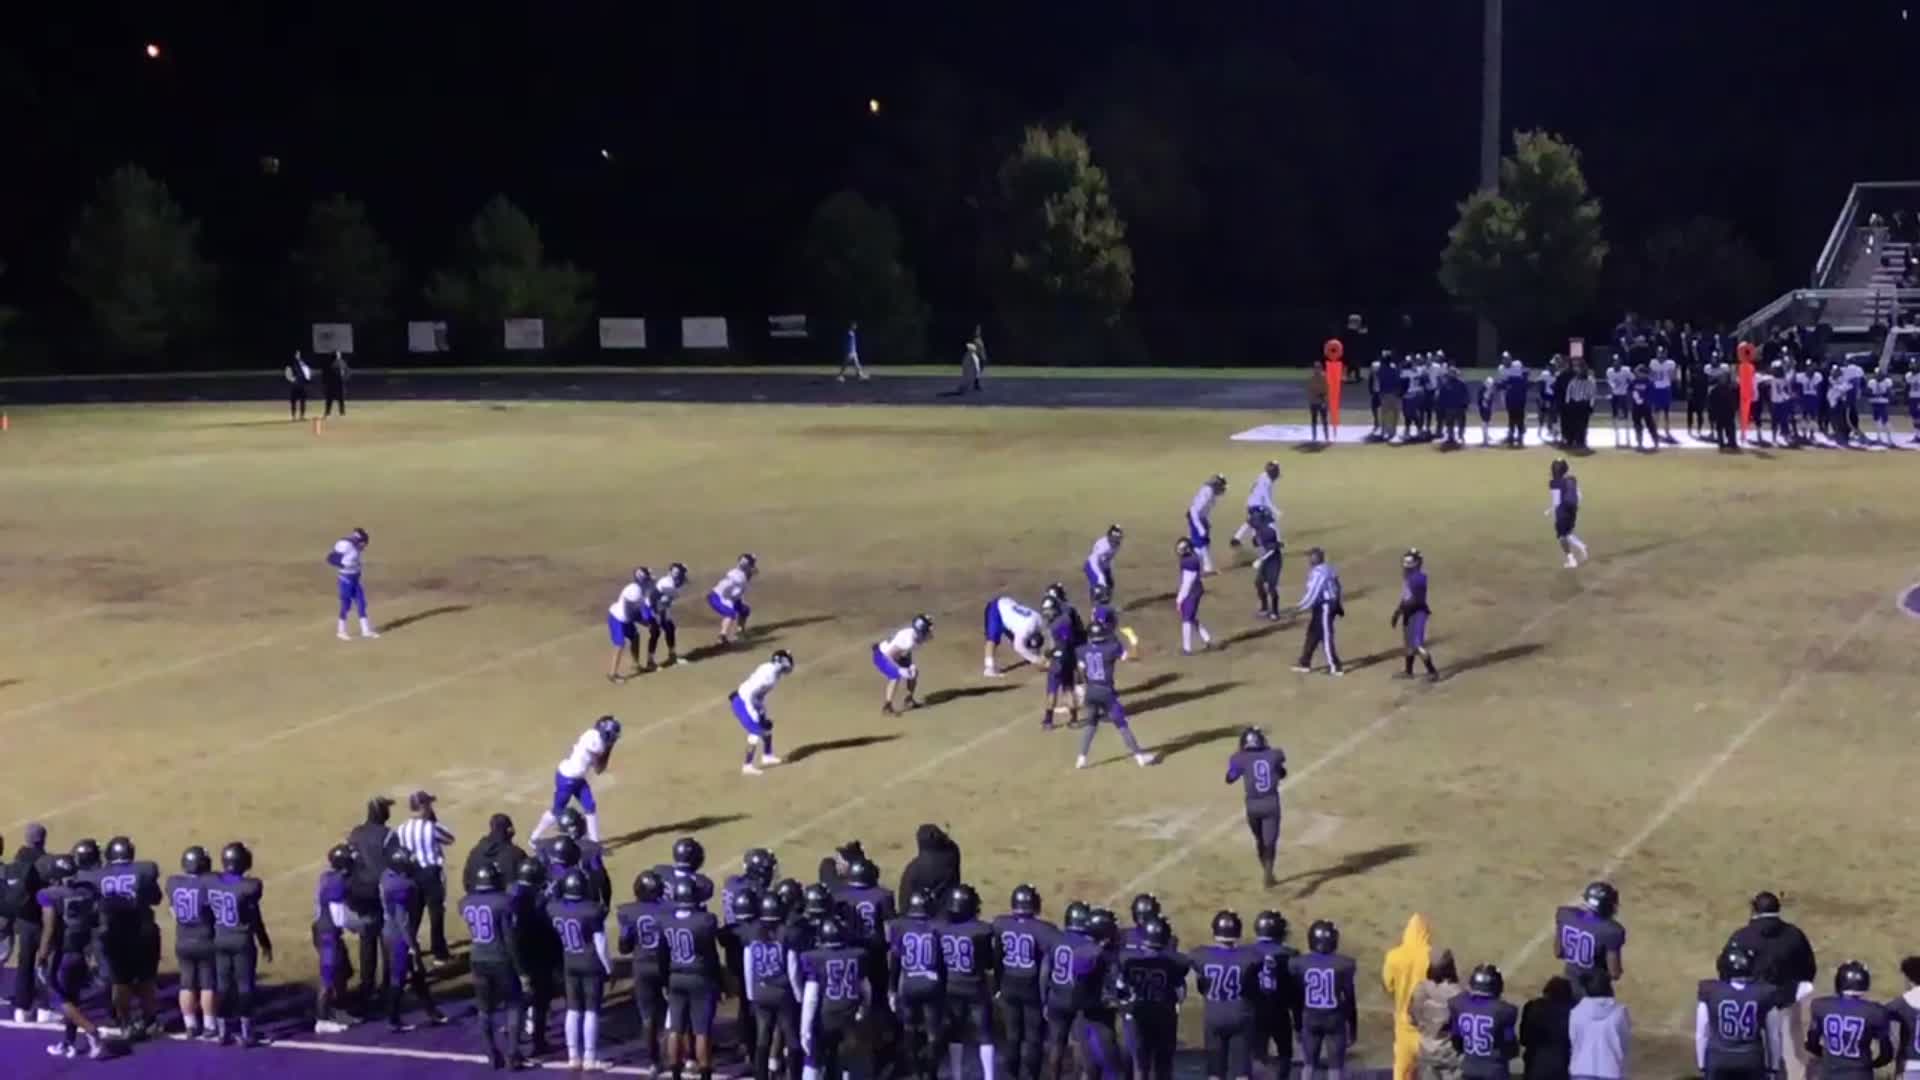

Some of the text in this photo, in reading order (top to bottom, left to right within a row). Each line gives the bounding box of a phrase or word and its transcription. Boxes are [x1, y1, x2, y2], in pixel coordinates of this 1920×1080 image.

[1253, 759, 1272, 793] 9
[172, 887, 199, 923] 61
[207, 889, 239, 927] 58
[664, 927, 696, 964] 10
[901, 932, 934, 971] 30
[941, 934, 974, 973] 28
[1001, 931, 1035, 968] 20
[1052, 945, 1074, 985] 9
[1562, 924, 1595, 968] 50
[826, 958, 859, 1000] 54
[1204, 963, 1242, 1001] 74
[1304, 967, 1338, 1009] 21
[1718, 1000, 1758, 1041] 64
[1824, 1014, 1866, 1058] 87
